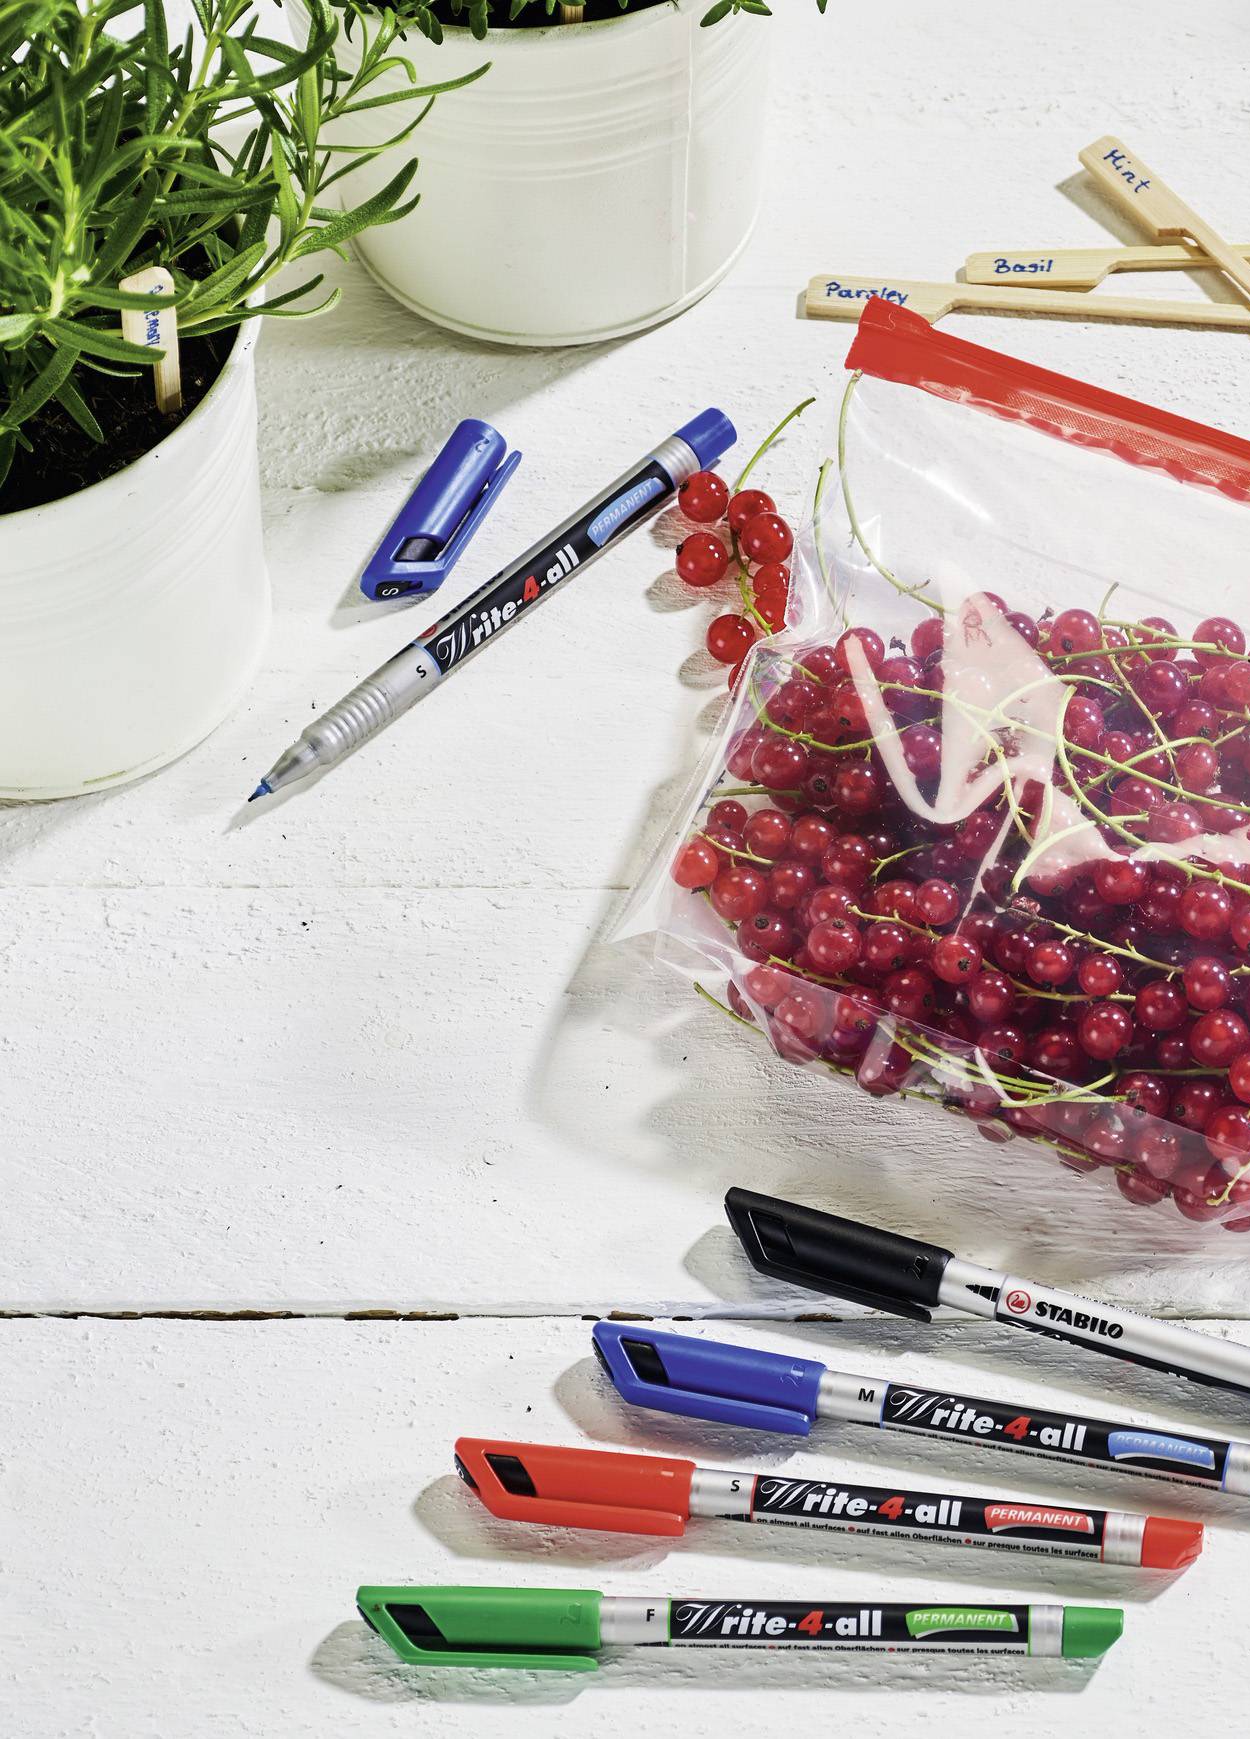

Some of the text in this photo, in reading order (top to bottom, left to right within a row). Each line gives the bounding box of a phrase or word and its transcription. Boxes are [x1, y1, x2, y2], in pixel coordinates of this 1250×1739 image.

[994, 258, 1053, 273] Basil
[592, 482, 653, 536] PERMANENT
[436, 543, 580, 668] Write-4-all
[416, 665, 427, 678] S
[1035, 1301, 1124, 1339] STABILO
[858, 1388, 875, 1403] M
[889, 1389, 1087, 1451] Write-4-all
[730, 1479, 740, 1492] S
[760, 1479, 1084, 1527] Write-4-all PERMANENT
[769, 1518, 798, 1528] almost
[812, 1523, 846, 1532] surfaces
[872, 1528, 888, 1537] fast
[890, 1530, 910, 1539] allen
[912, 1532, 962, 1545] Oberflächen
[972, 1539, 986, 1547] sur
[988, 1541, 1020, 1552] presque
[1022, 1544, 1049, 1554] toutes
[1051, 1546, 1062, 1555] les
[1064, 1548, 1098, 1559] surfaces
[646, 1608, 655, 1622] F
[675, 1603, 1008, 1636] Write-4-all PERMANENT
